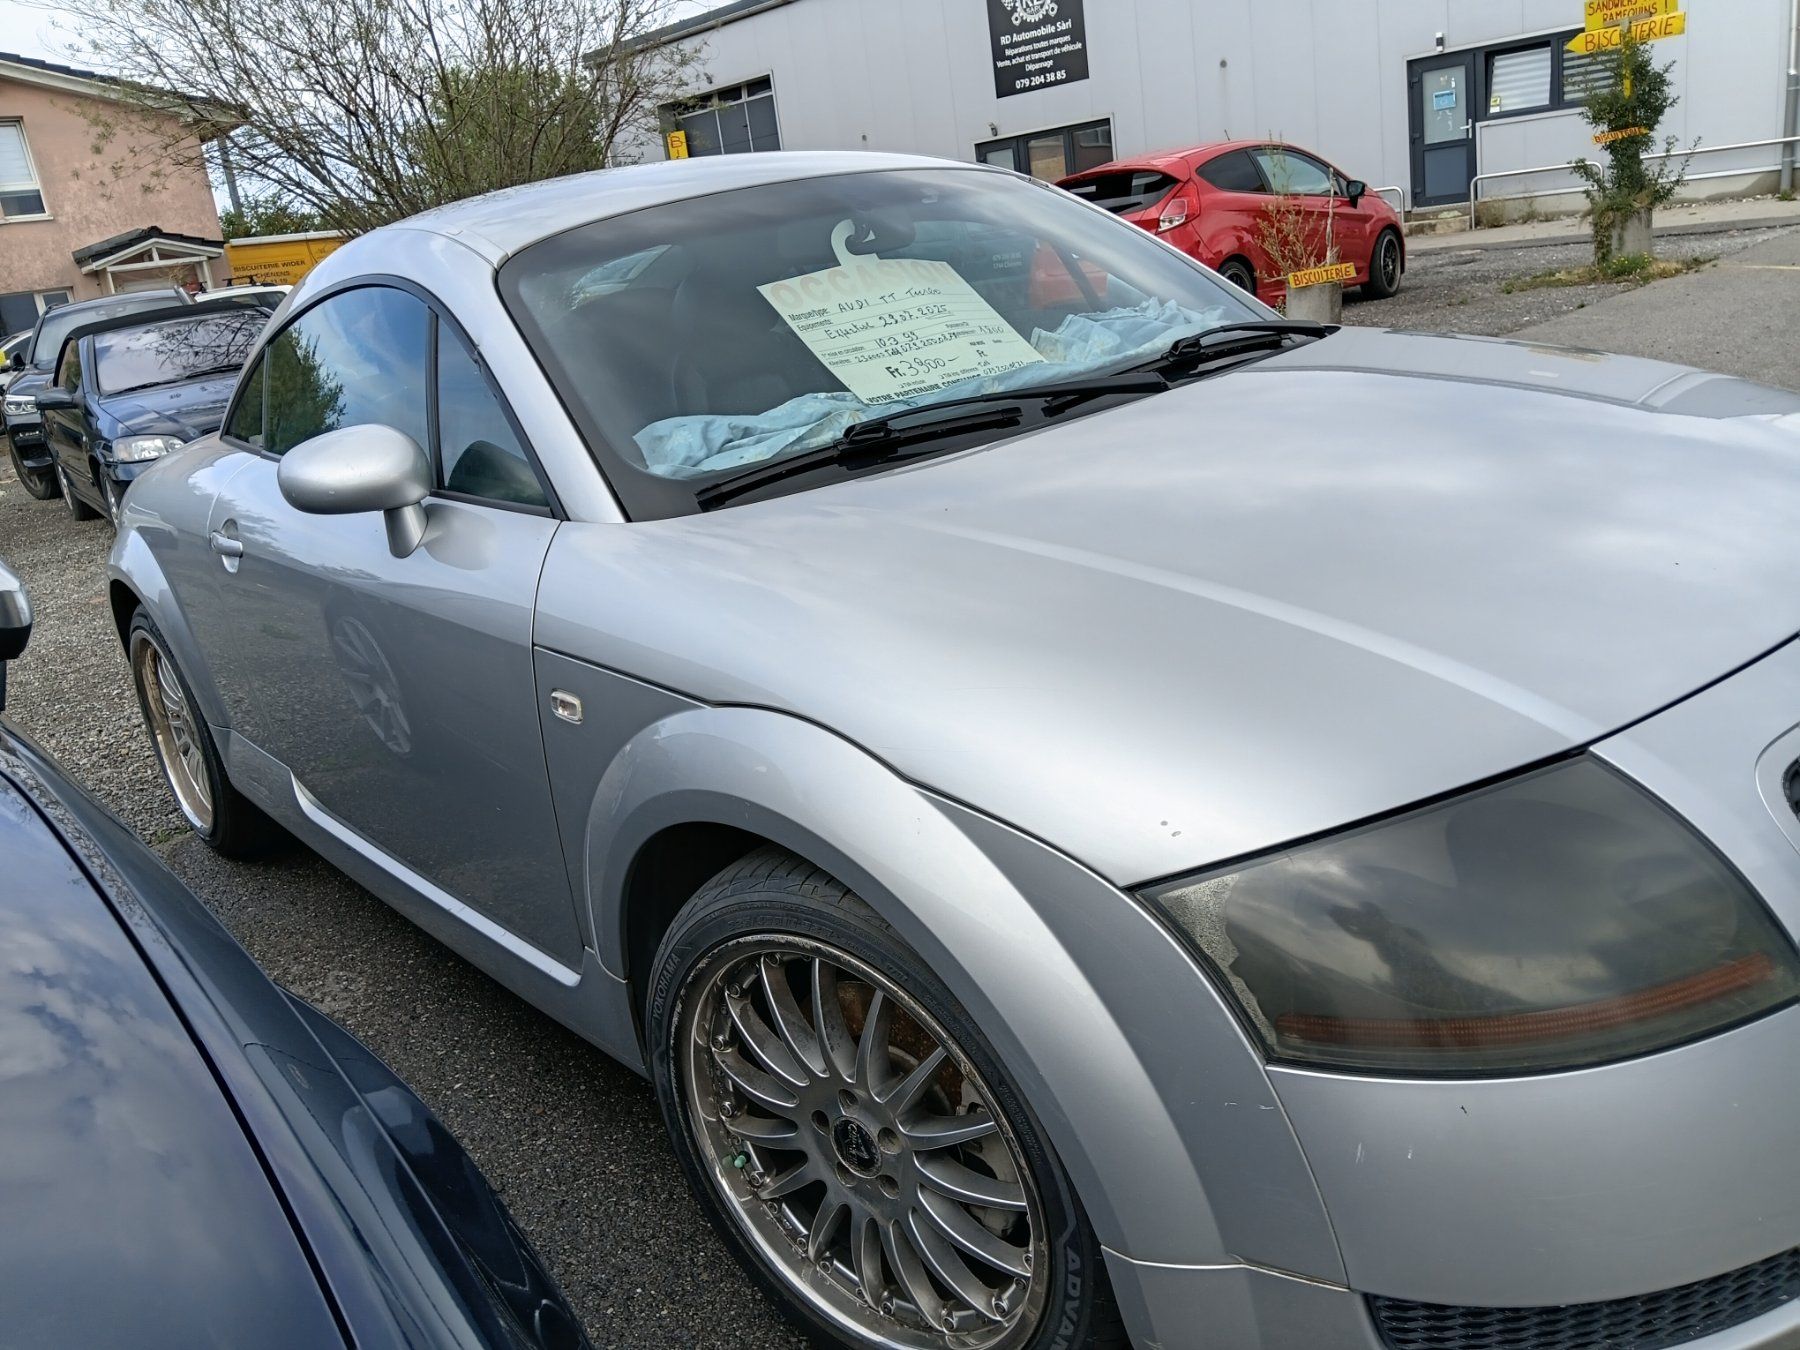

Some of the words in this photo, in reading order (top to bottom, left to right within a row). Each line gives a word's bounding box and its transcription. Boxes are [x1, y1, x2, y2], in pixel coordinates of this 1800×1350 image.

[1000, 35, 1011, 46] RD
[1012, 25, 1056, 43] Automobile
[1584, 16, 1676, 52] BISCTERIE
[996, 60, 1011, 69] Vente,
[1011, 56, 1025, 65] achat
[1031, 48, 1054, 60] transport
[1054, 46, 1061, 55] de
[1061, 41, 1082, 52] véhicule
[1005, 45, 1033, 56] Réparations
[1033, 40, 1049, 50] toutes
[1049, 35, 1071, 46] marques
[1025, 59, 1054, 71] Dépannage
[1015, 78, 1030, 89] 079
[1030, 75, 1045, 86] 204
[1045, 72, 1056, 83] 38
[1056, 70, 1067, 80] 85
[233, 262, 280, 273] BISCUITERIE
[281, 260, 306, 268] WIDER
[1292, 265, 1352, 286] BISCUITERIE
[770, 260, 957, 311] OCCASION
[838, 299, 870, 313] AUDI
[885, 366, 907, 378] Fr.
[866, 393, 895, 403] VOTRE
[894, 383, 942, 398] PARTENAIRE
[651, 952, 681, 1020] YOKOHAMA
